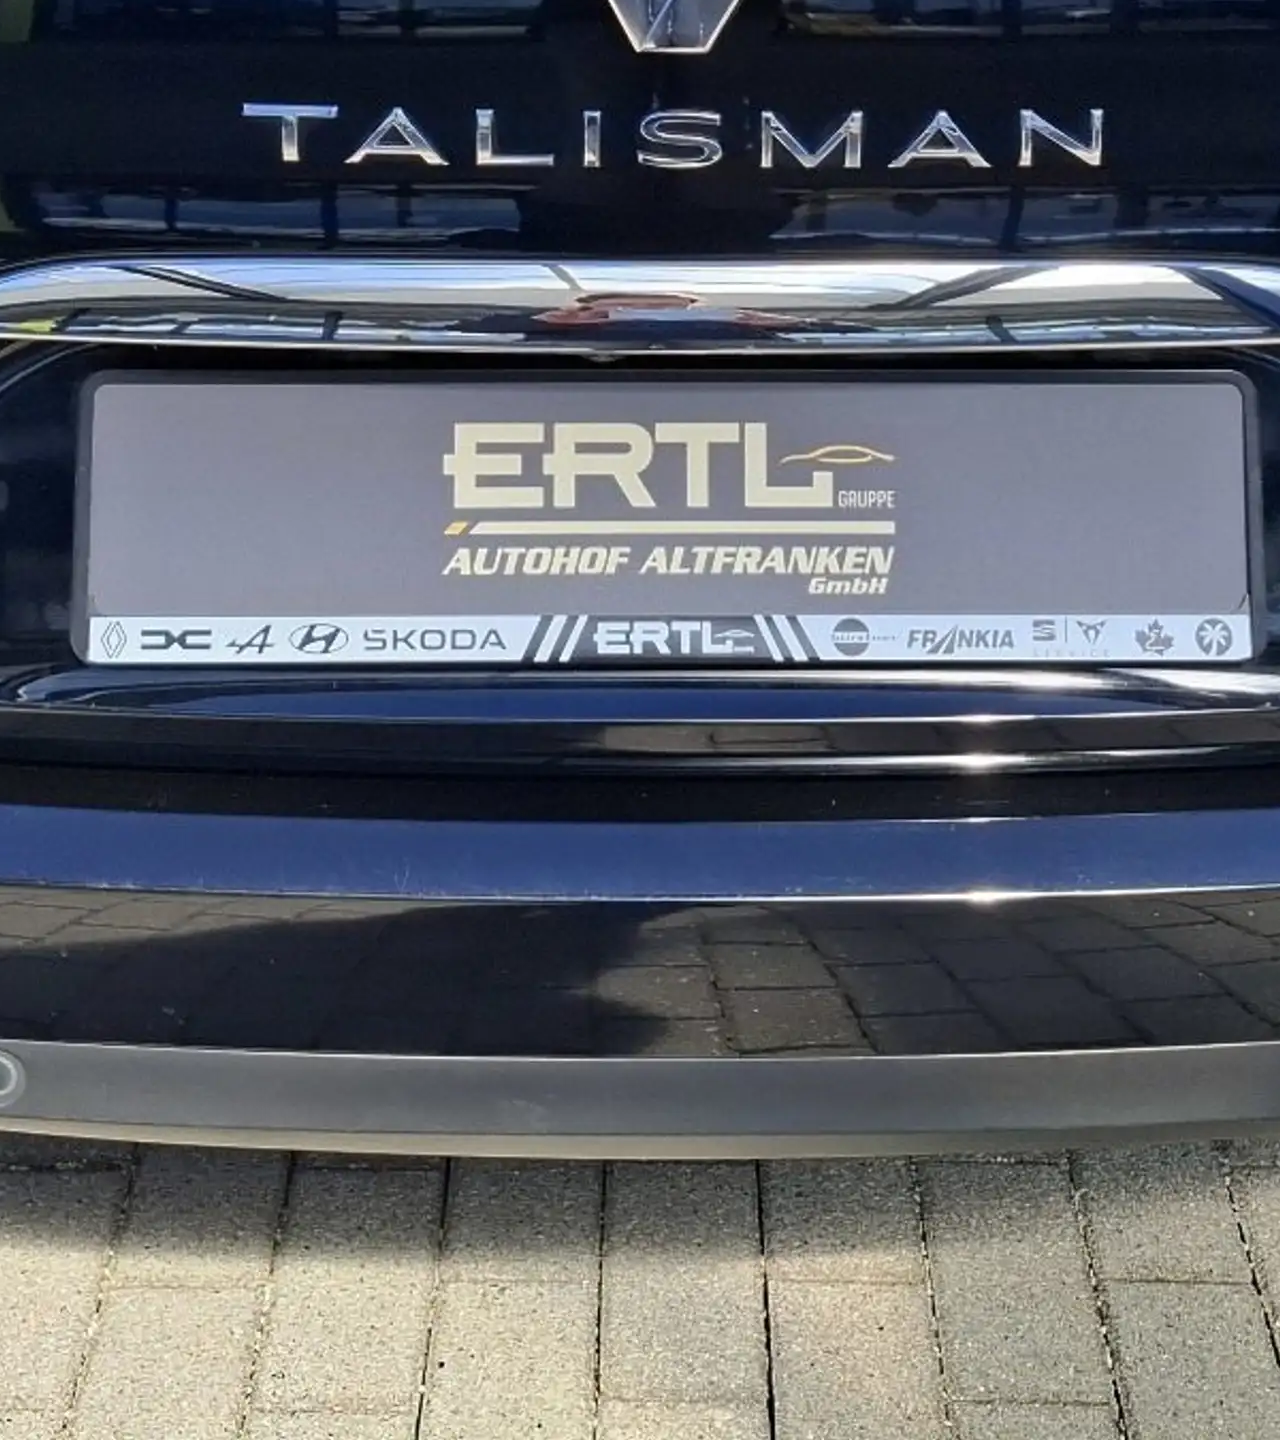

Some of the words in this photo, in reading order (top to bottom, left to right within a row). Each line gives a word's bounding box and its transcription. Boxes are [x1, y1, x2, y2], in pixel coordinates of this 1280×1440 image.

[242, 103, 1104, 168] TALISMAN
[443, 422, 833, 508] ERTL
[442, 546, 631, 576] AUTOHOF
[639, 545, 895, 576] ALTFRANKEN
[808, 576, 889, 595] GmbH
[593, 620, 734, 655] ERTL
[907, 624, 1015, 655] FRANKIA
